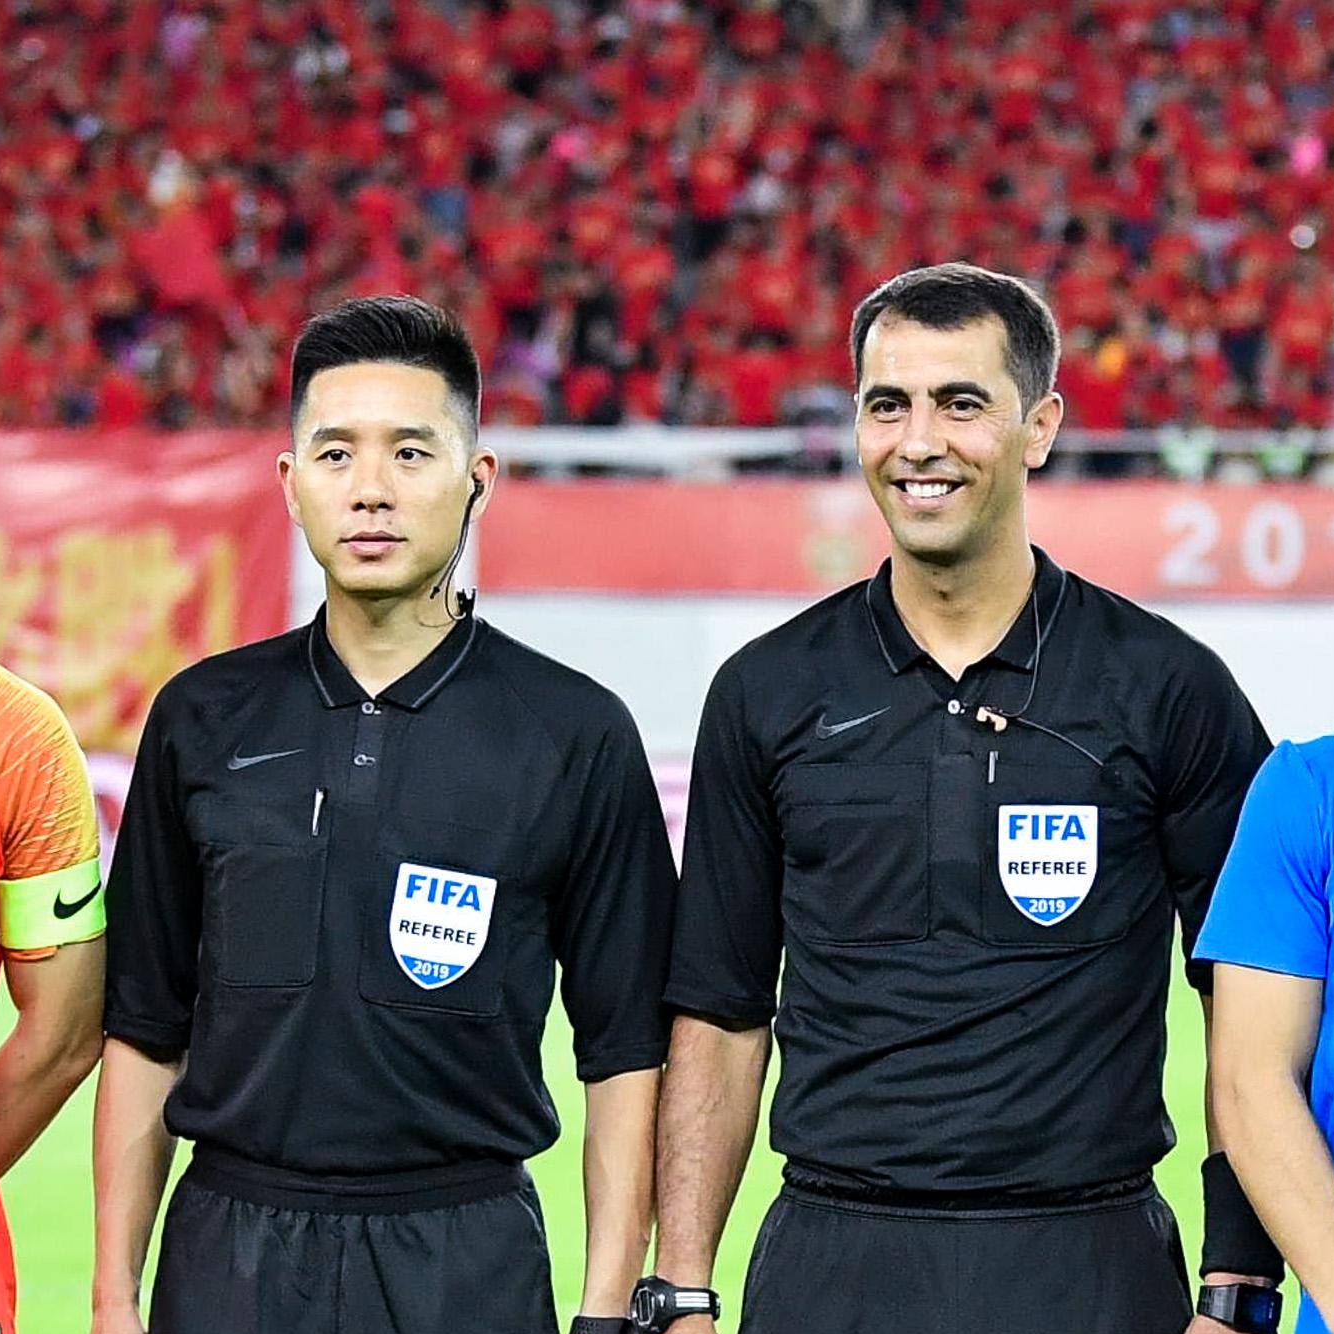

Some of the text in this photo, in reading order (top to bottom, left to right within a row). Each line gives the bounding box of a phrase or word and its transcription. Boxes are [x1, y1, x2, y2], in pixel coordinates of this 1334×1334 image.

[1009, 814, 1086, 840] FIFA
[1008, 861, 1087, 875] REFEREE
[405, 873, 481, 911] FIFA
[1028, 899, 1066, 914] 2019
[399, 919, 478, 946] REFEREE
[411, 960, 450, 979] 2019
